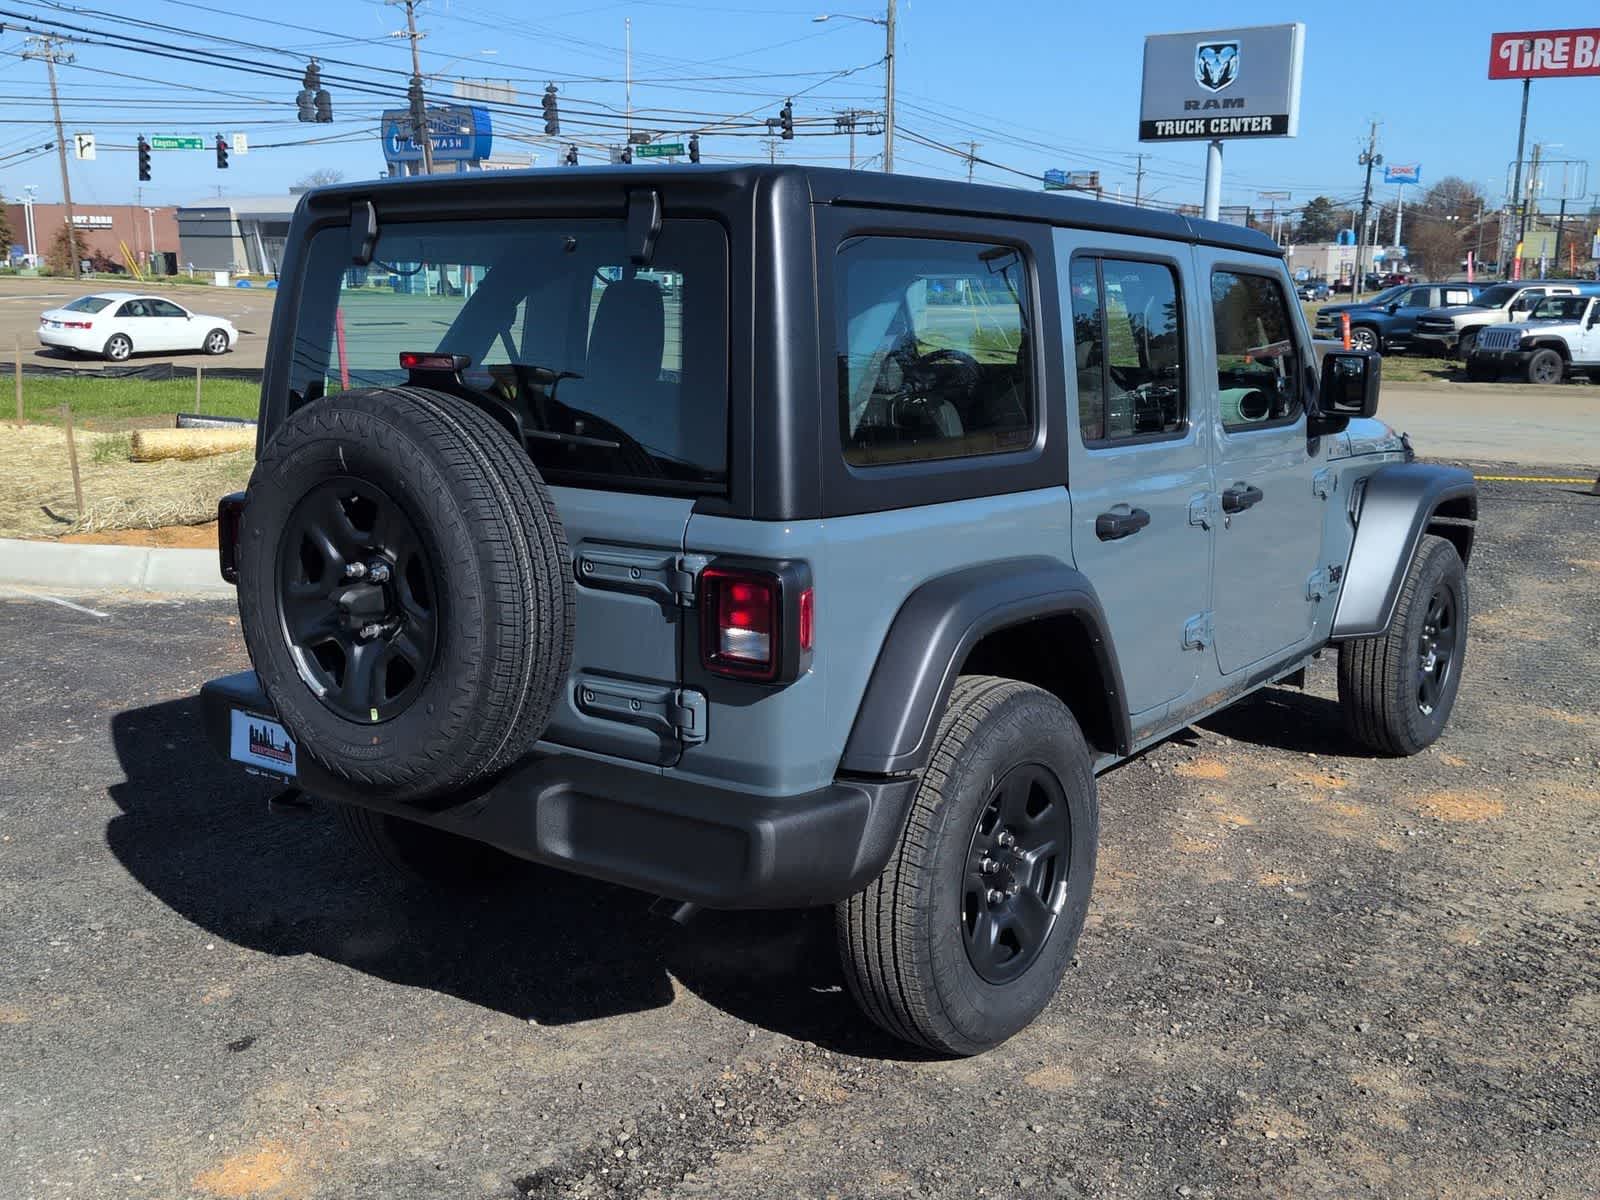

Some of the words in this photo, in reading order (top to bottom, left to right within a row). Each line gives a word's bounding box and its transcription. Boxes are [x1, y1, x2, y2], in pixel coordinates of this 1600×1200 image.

[1499, 36, 1570, 71] TIRE
[1184, 98, 1244, 111] RAM
[1155, 119, 1205, 136] TRUCK
[1210, 116, 1272, 133] CENTER
[433, 138, 462, 148] WASH
